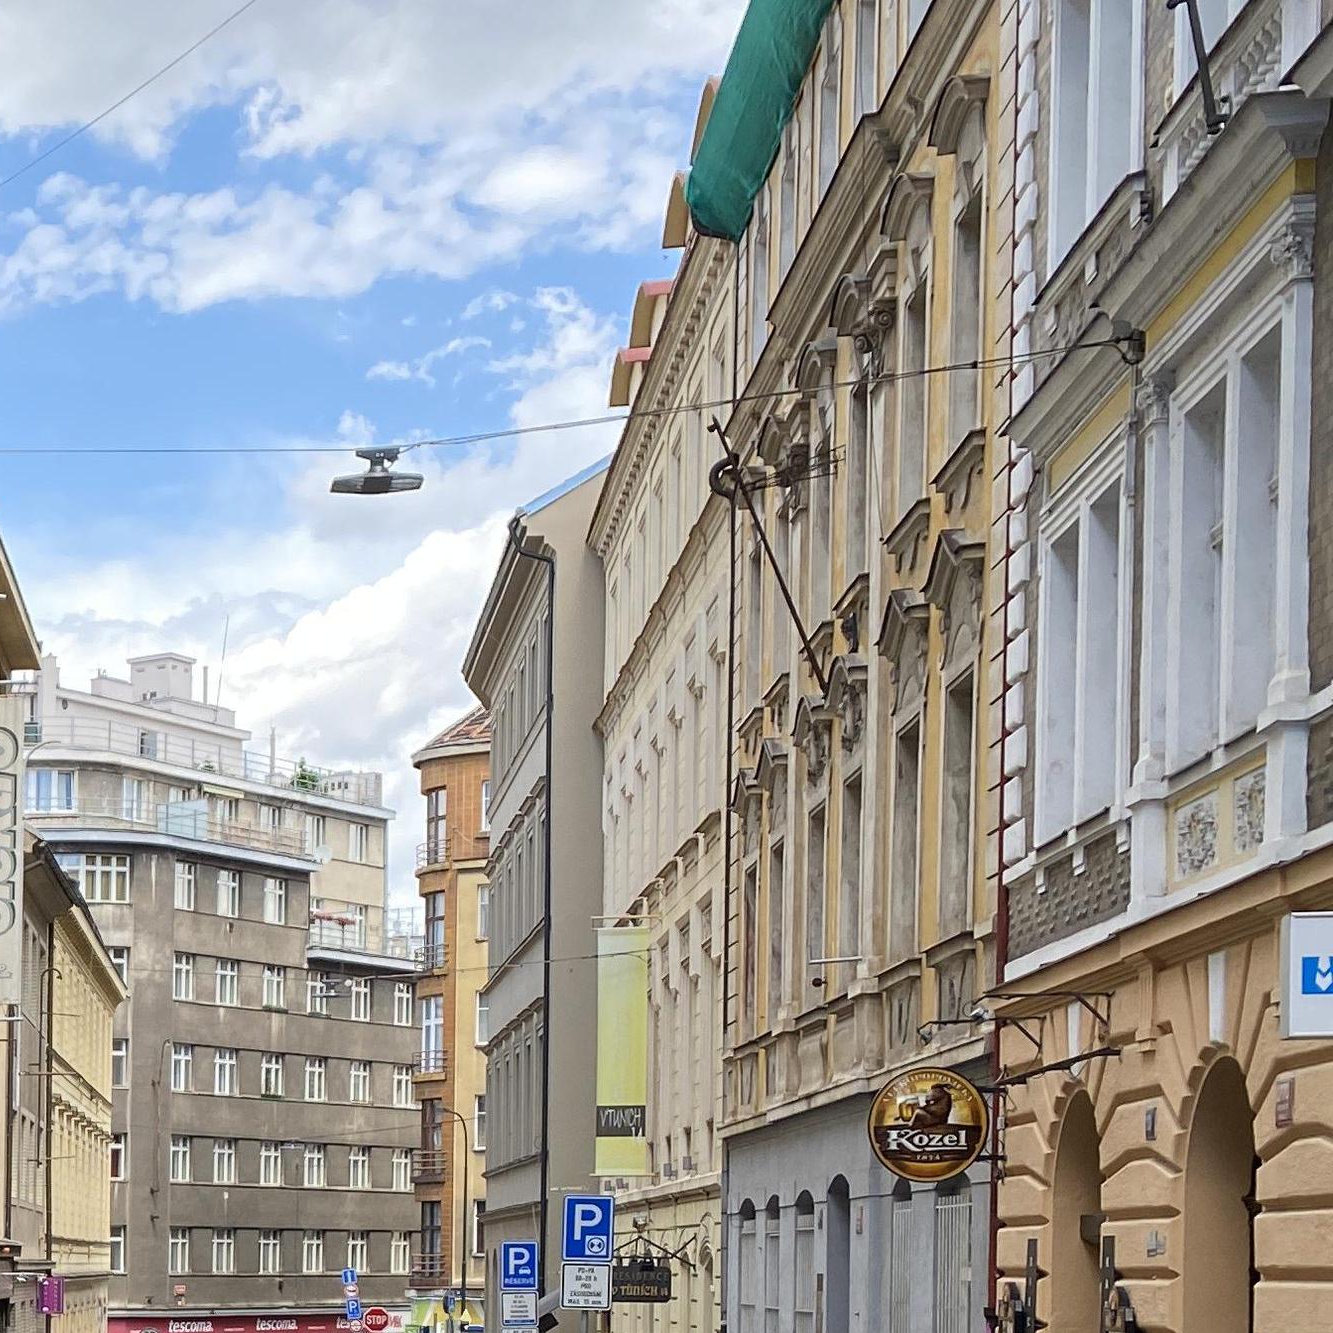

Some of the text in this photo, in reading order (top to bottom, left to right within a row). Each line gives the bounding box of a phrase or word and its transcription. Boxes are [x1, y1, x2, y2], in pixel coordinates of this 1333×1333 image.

[886, 1129, 968, 1152] Kozel
[573, 1203, 603, 1241] P
[508, 1247, 531, 1275] P
[366, 1314, 387, 1326] STOP
